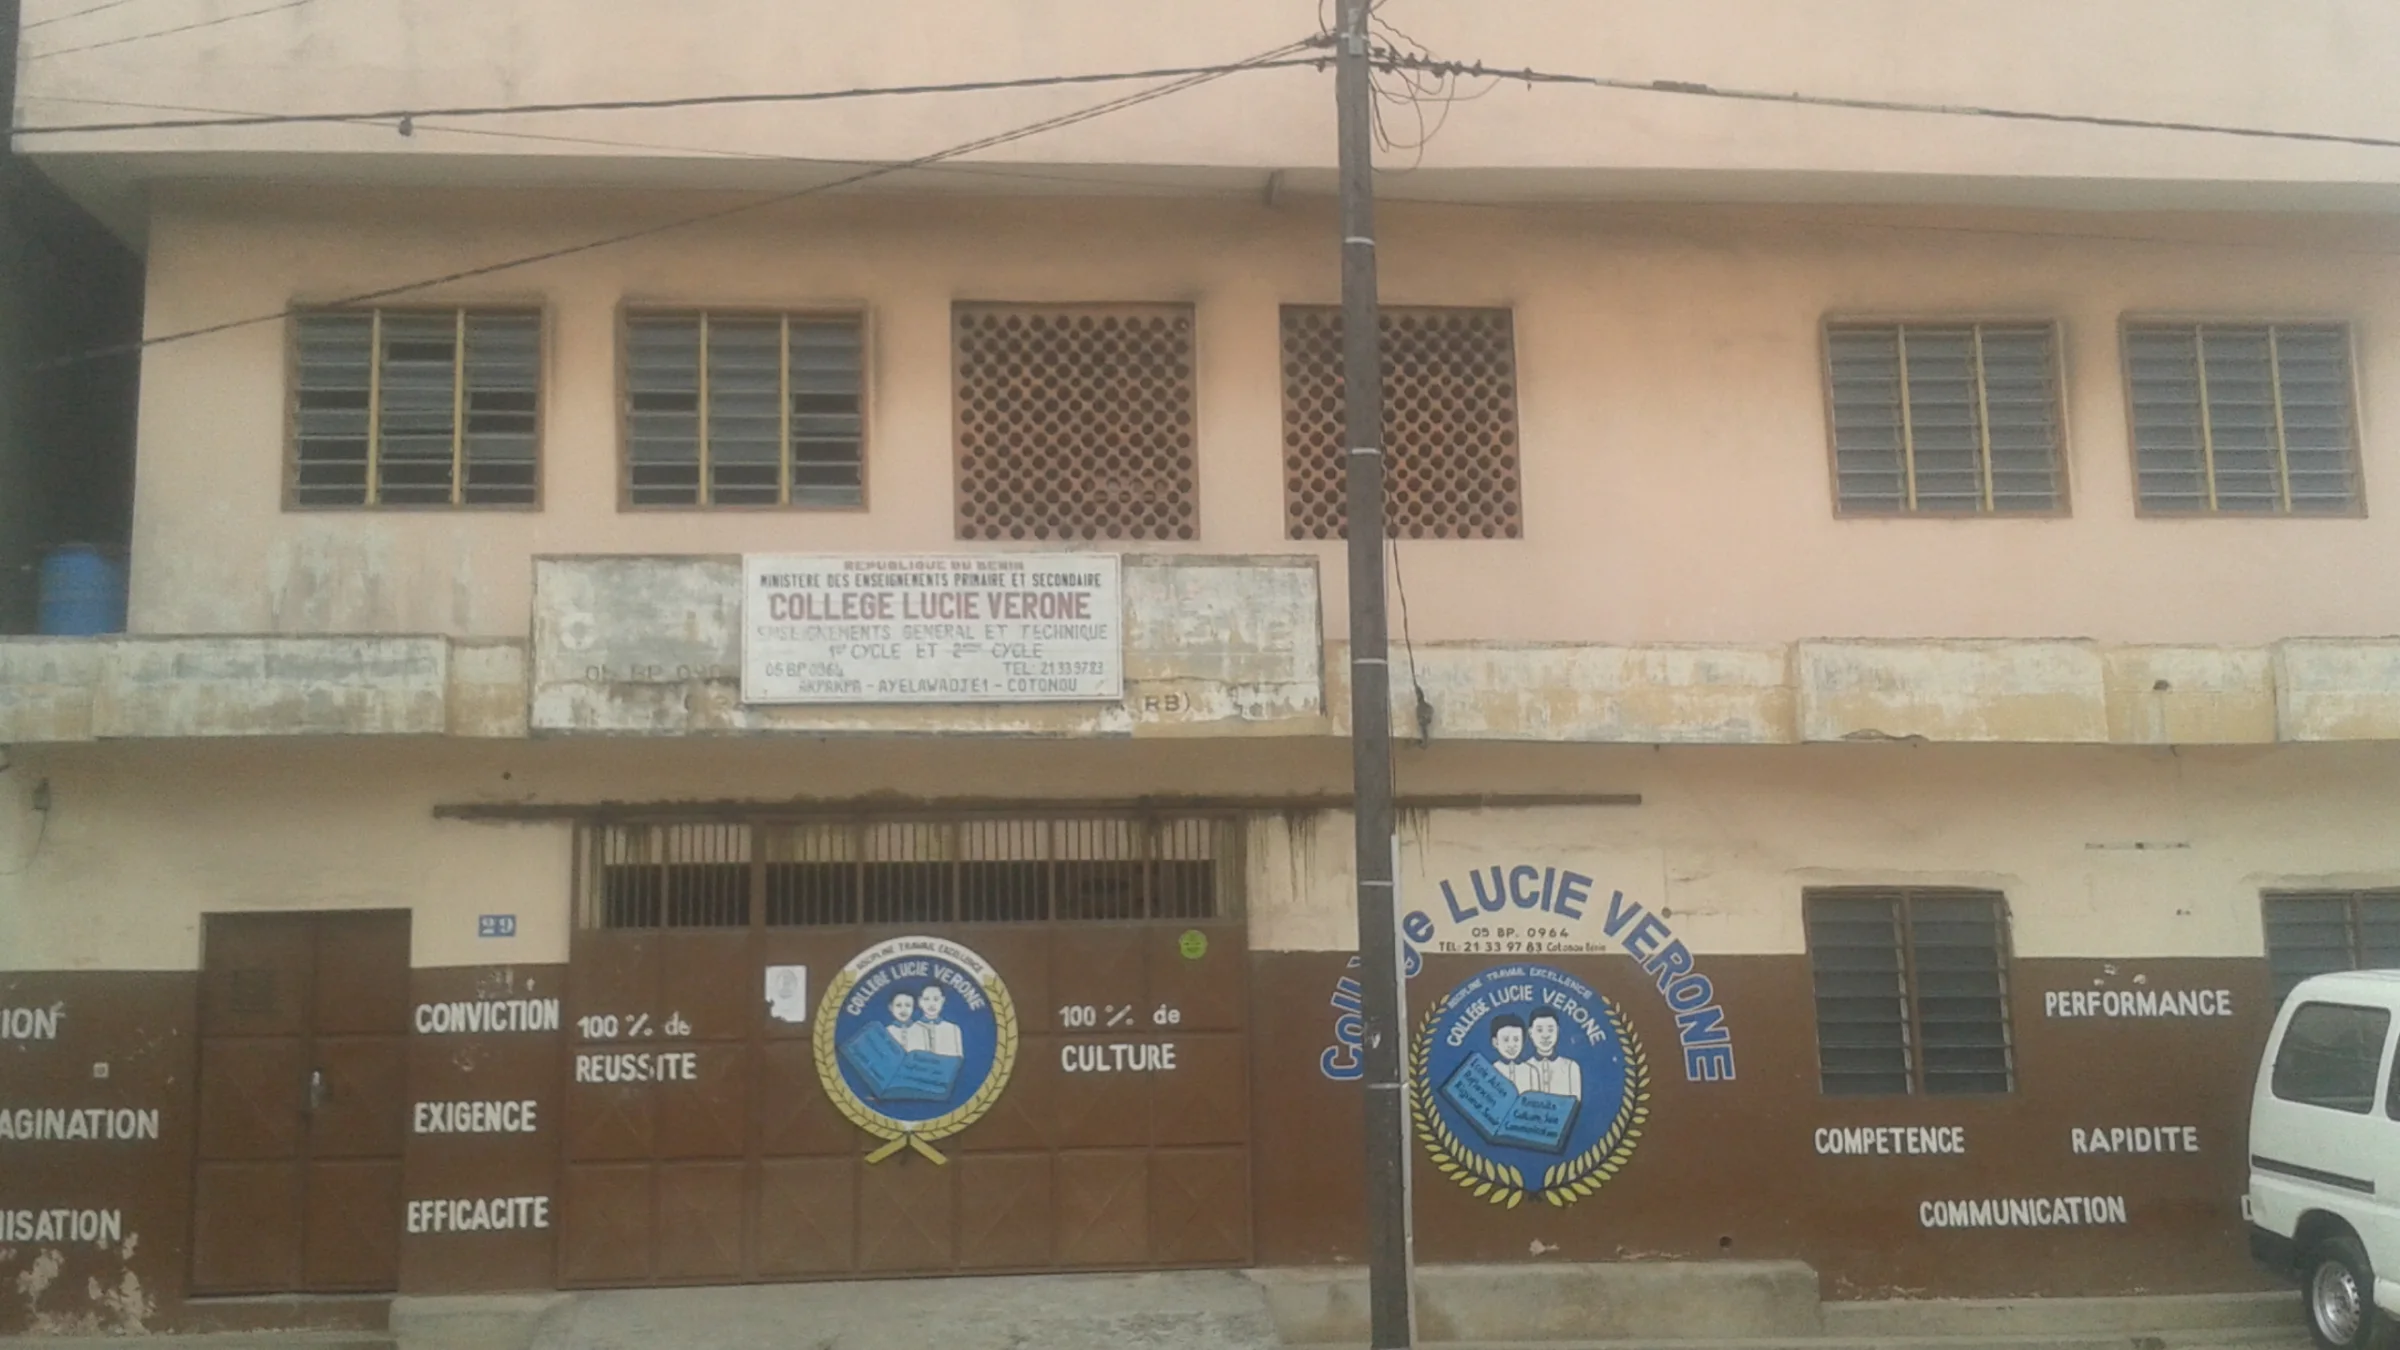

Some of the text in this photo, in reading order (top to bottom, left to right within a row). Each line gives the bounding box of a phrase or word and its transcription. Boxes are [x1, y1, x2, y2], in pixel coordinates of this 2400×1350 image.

[760, 573, 1102, 588] MINISTERE DES ENSEIGNEMENTS PRIMAIRE ET SECONDAIRE
[769, 592, 1091, 621] COLLEGE LUCIE VERONE
[903, 624, 975, 640] GENERAL
[985, 624, 1008, 640] ET
[1020, 624, 1108, 641] TECHNIQUE
[850, 643, 901, 659] CYCLE
[916, 643, 938, 658] ET
[991, 642, 1043, 658] CYCLE
[1007, 678, 1078, 693] COTONOU
[482, 917, 513, 934] 29
[1471, 927, 1490, 938] 05
[1527, 927, 1569, 938] 0964
[1463, 942, 1479, 953] 21
[1485, 942, 1501, 953] 33
[1507, 942, 1522, 953] 97
[1526, 942, 1542, 954] 83
[890, 960, 930, 981] LUCIE
[933, 963, 986, 1012] VERONE
[1439, 864, 1594, 924] LUCIE
[1602, 889, 1737, 1082] VERONE
[416, 999, 560, 1034] CONVICTION
[1059, 1005, 1097, 1028] 100
[1153, 1003, 1181, 1025] de
[1446, 984, 1607, 1047] COLLEGE LUCIE VERONE
[2045, 990, 2233, 1017] PERFORMANCE
[0, 1008, 57, 1039] ION
[576, 1014, 619, 1039] 100
[664, 1010, 692, 1036] de
[1061, 1043, 1177, 1072] CULTURE
[0, 1108, 159, 1140] AGINATION
[413, 1101, 537, 1133] EXIGENCE
[1815, 1126, 1966, 1156] COMPETENCE
[2071, 1126, 2199, 1153] RAPIDITE
[0, 1208, 122, 1241] ISATION
[407, 1196, 549, 1233] EFFICACITE
[1919, 1196, 2127, 1227] COMMUNICATION
